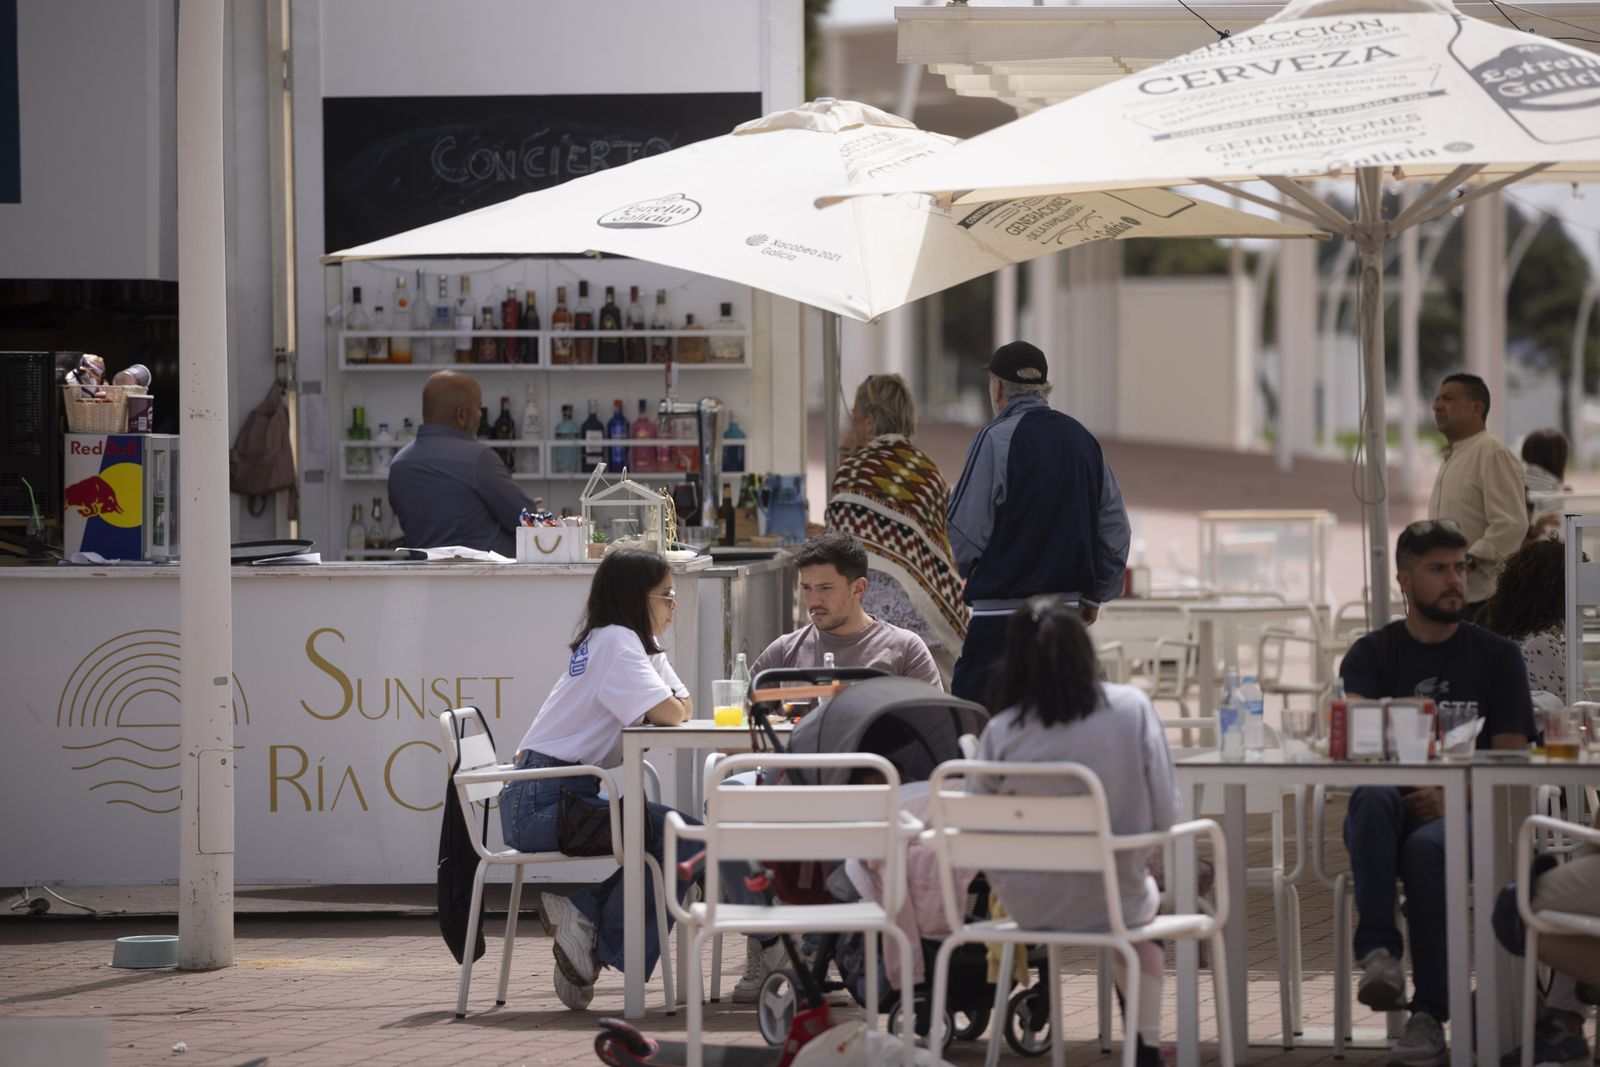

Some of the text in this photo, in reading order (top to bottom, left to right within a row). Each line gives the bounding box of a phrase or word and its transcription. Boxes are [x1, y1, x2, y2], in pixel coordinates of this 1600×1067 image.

[1190, 17, 1384, 54] RFECCIÓN
[1138, 45, 1400, 95] CERVEZA
[1480, 56, 1600, 84] Estrell
[1205, 112, 1422, 153] GENERACIONES
[761, 246, 797, 261] Galicia
[769, 238, 843, 262] Xacobeo 2021
[71, 441, 102, 455] Red
